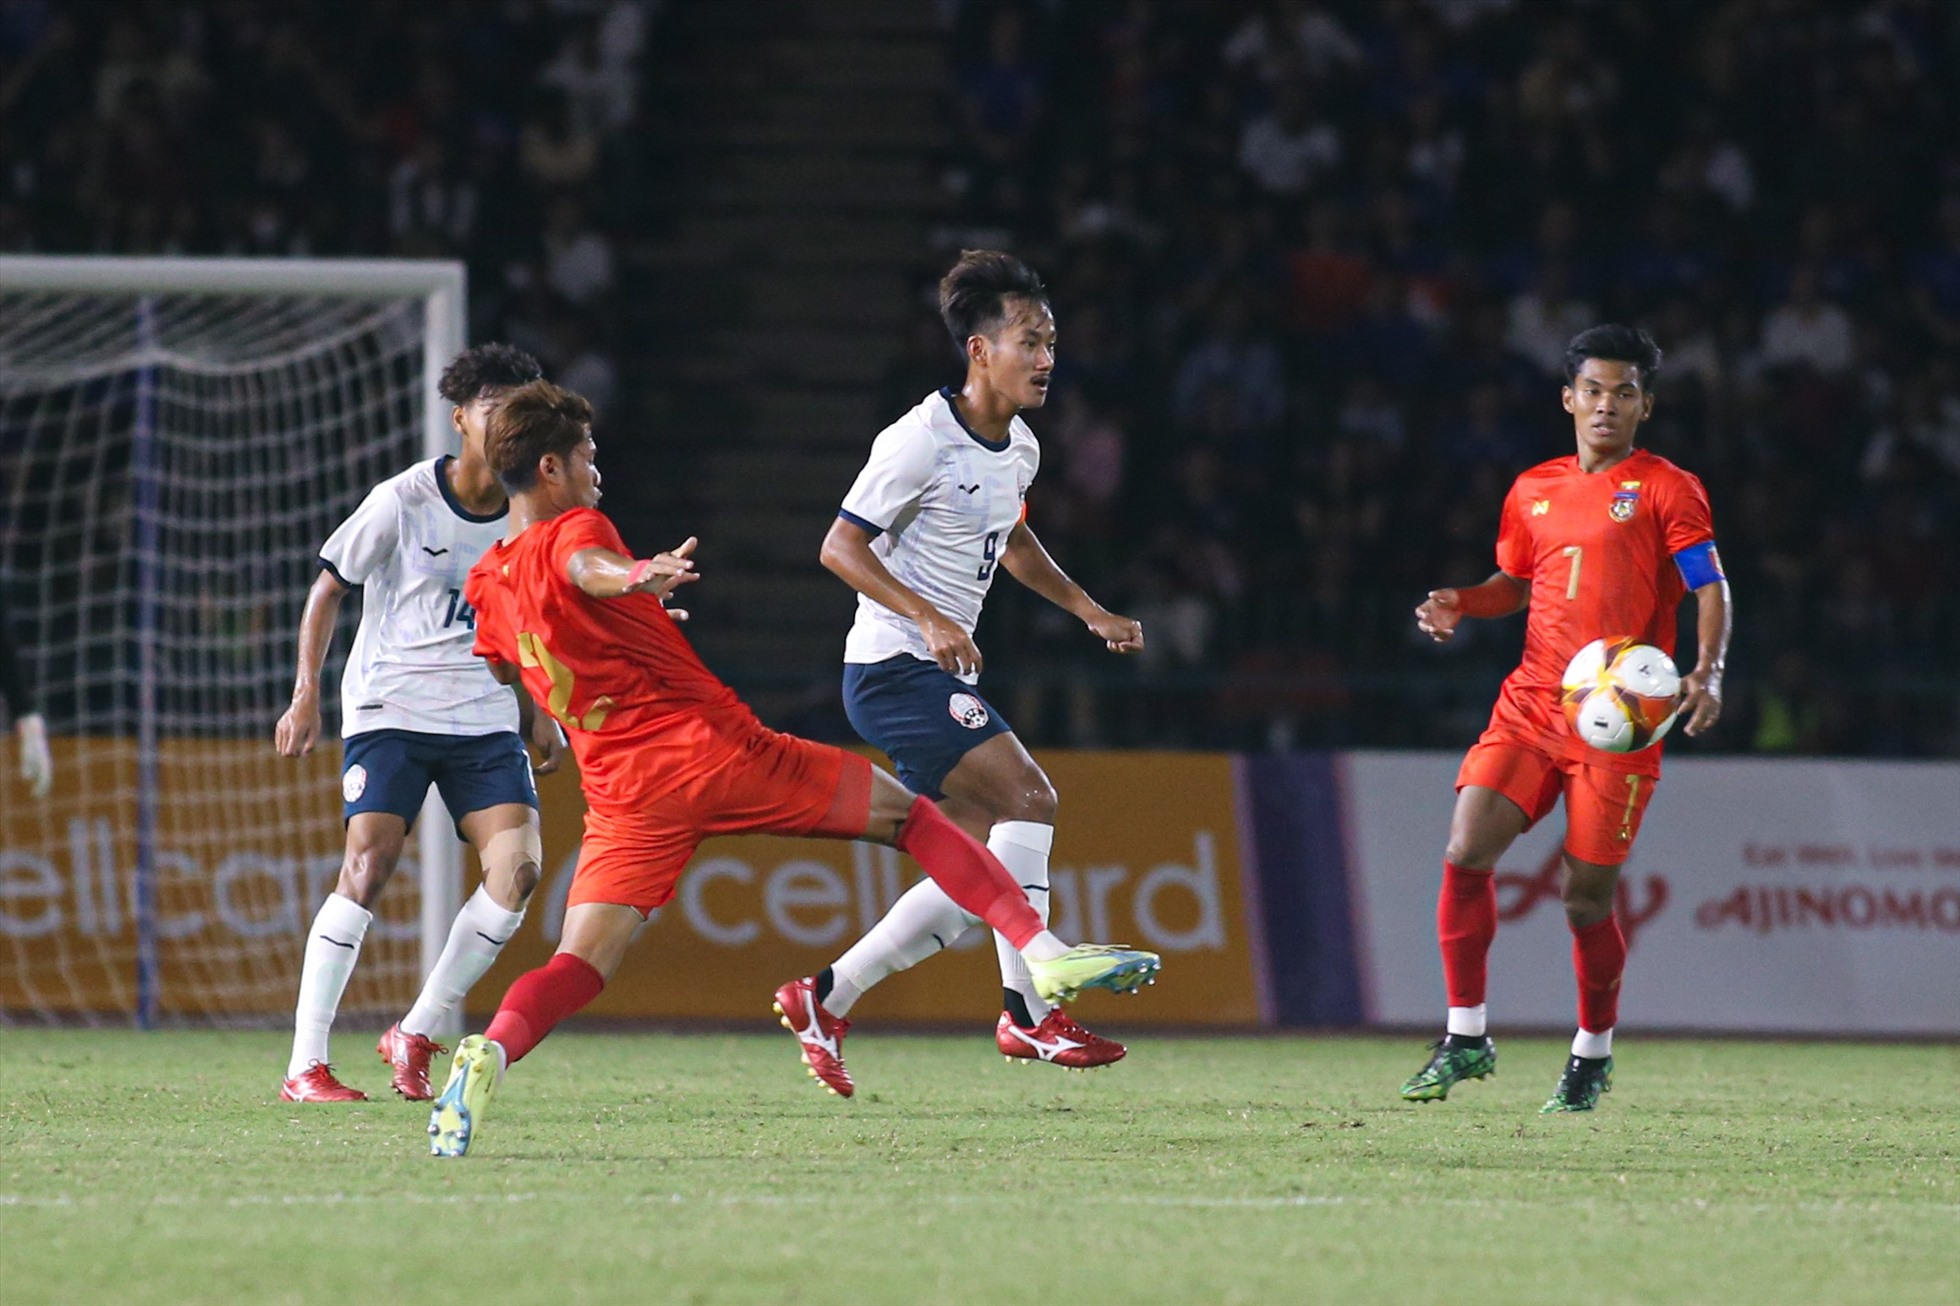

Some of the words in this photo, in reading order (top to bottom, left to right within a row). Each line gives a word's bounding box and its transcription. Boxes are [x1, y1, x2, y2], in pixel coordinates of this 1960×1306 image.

[977, 531, 999, 581] 9
[1563, 546, 1583, 601] 7
[443, 591, 477, 630] 14
[682, 830, 1225, 949] cellrd
